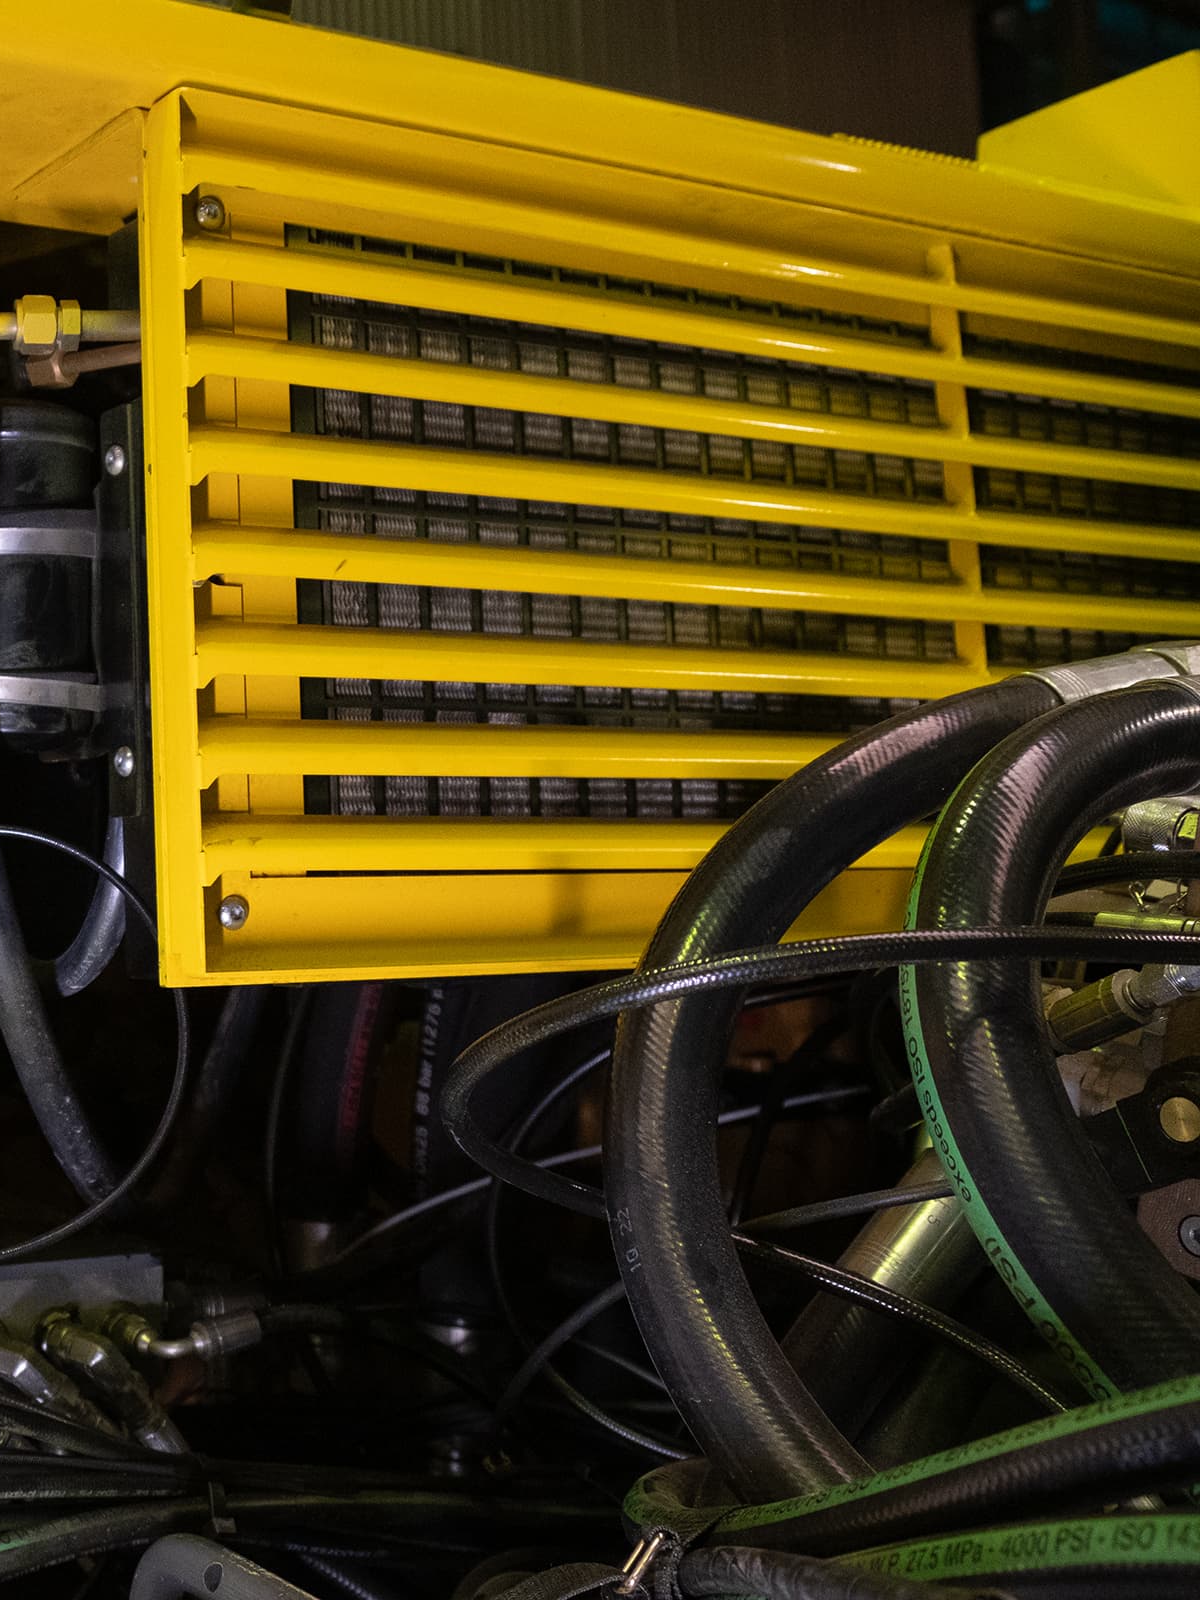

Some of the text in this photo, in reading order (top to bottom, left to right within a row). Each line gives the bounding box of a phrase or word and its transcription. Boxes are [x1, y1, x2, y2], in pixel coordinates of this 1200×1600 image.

[906, 1036, 926, 1085] ISO
[922, 1090, 973, 1204] exceeds
[904, 1543, 939, 1571] 27.5
[942, 1538, 983, 1567] MPa
[1000, 1531, 1051, 1559] 4000
[1054, 1526, 1094, 1555] PSI
[1111, 1520, 1157, 1552] ISO
